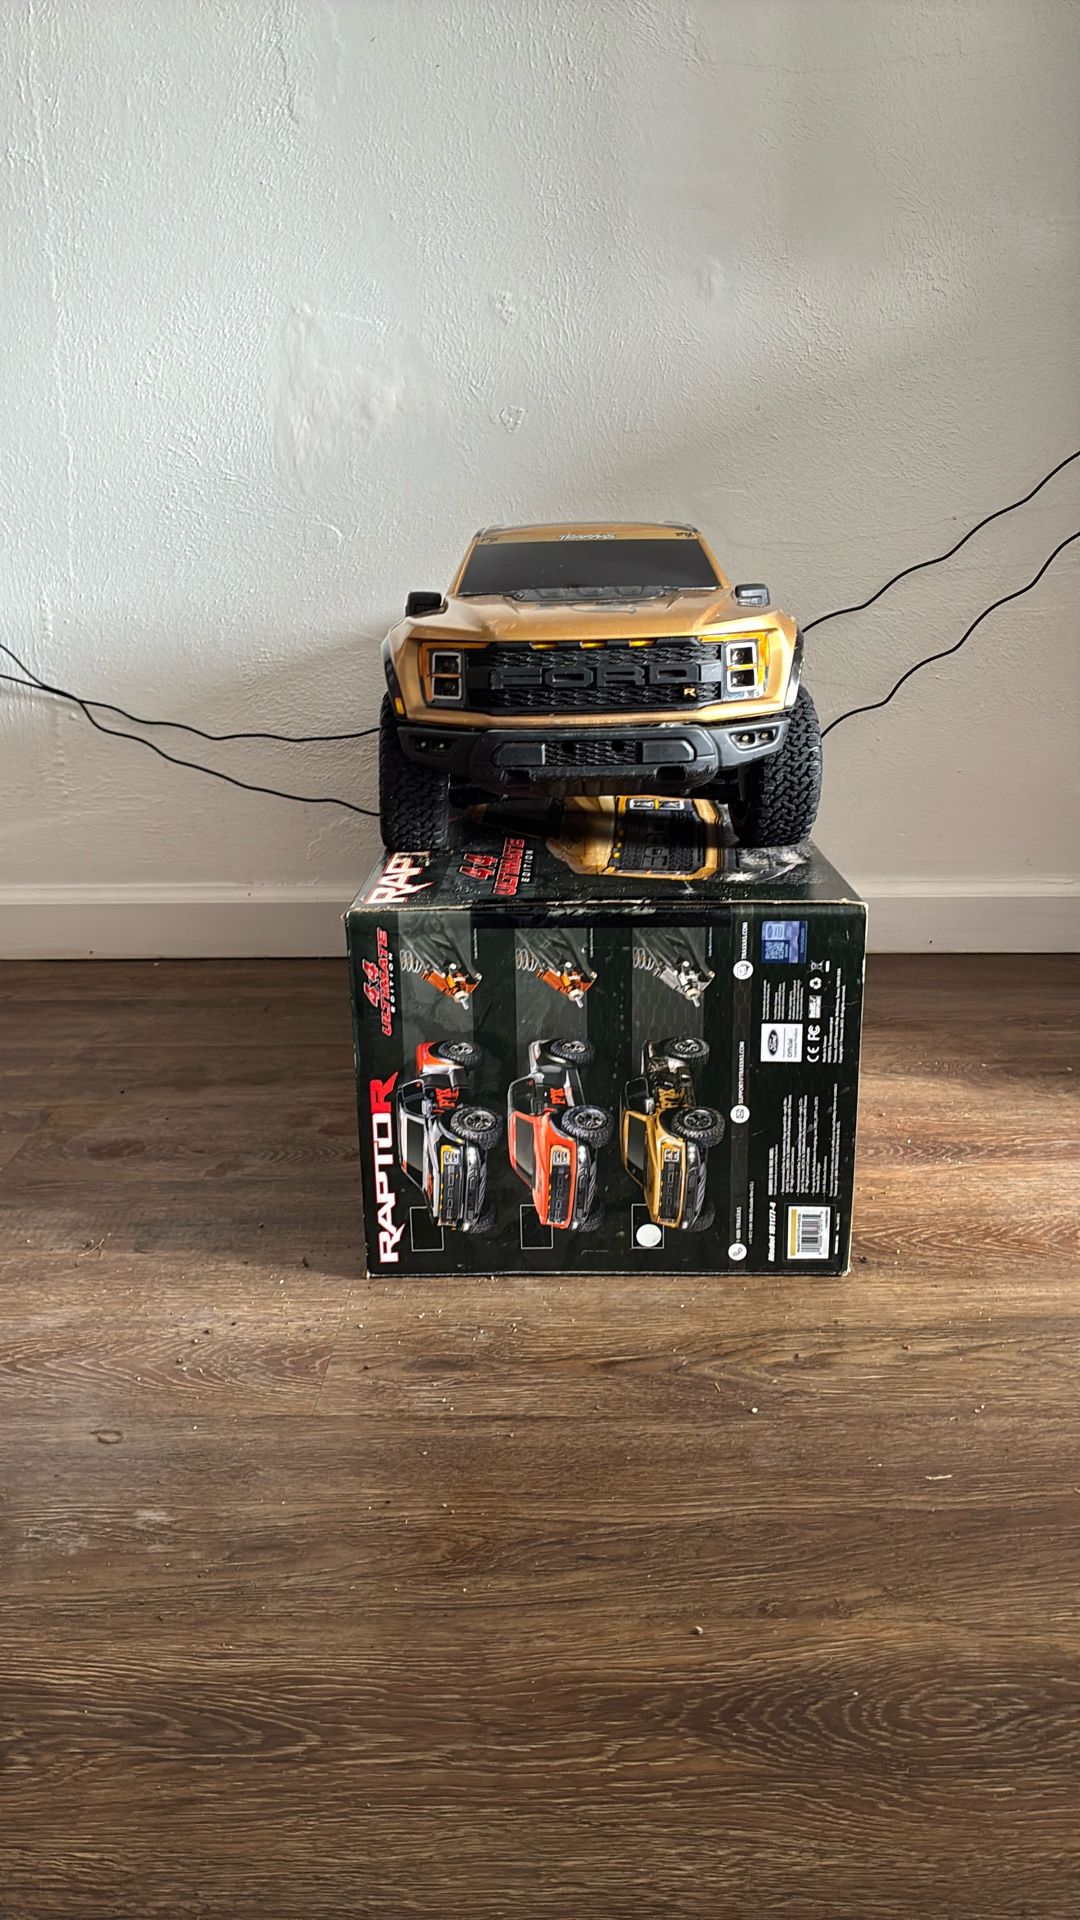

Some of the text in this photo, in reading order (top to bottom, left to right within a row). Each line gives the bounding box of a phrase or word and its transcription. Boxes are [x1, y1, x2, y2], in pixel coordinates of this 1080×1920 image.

[490, 663, 701, 690] FORD
[684, 687, 696, 697] R
[366, 850, 433, 905] RAPT
[492, 837, 525, 896] ULTIMATE
[521, 850, 534, 882] EDITION
[741, 922, 749, 959] TRAXXAS.COM
[376, 927, 392, 1037] ULTIMATE
[387, 952, 396, 1013] EDITION
[369, 1071, 405, 1264] RAPTOR
